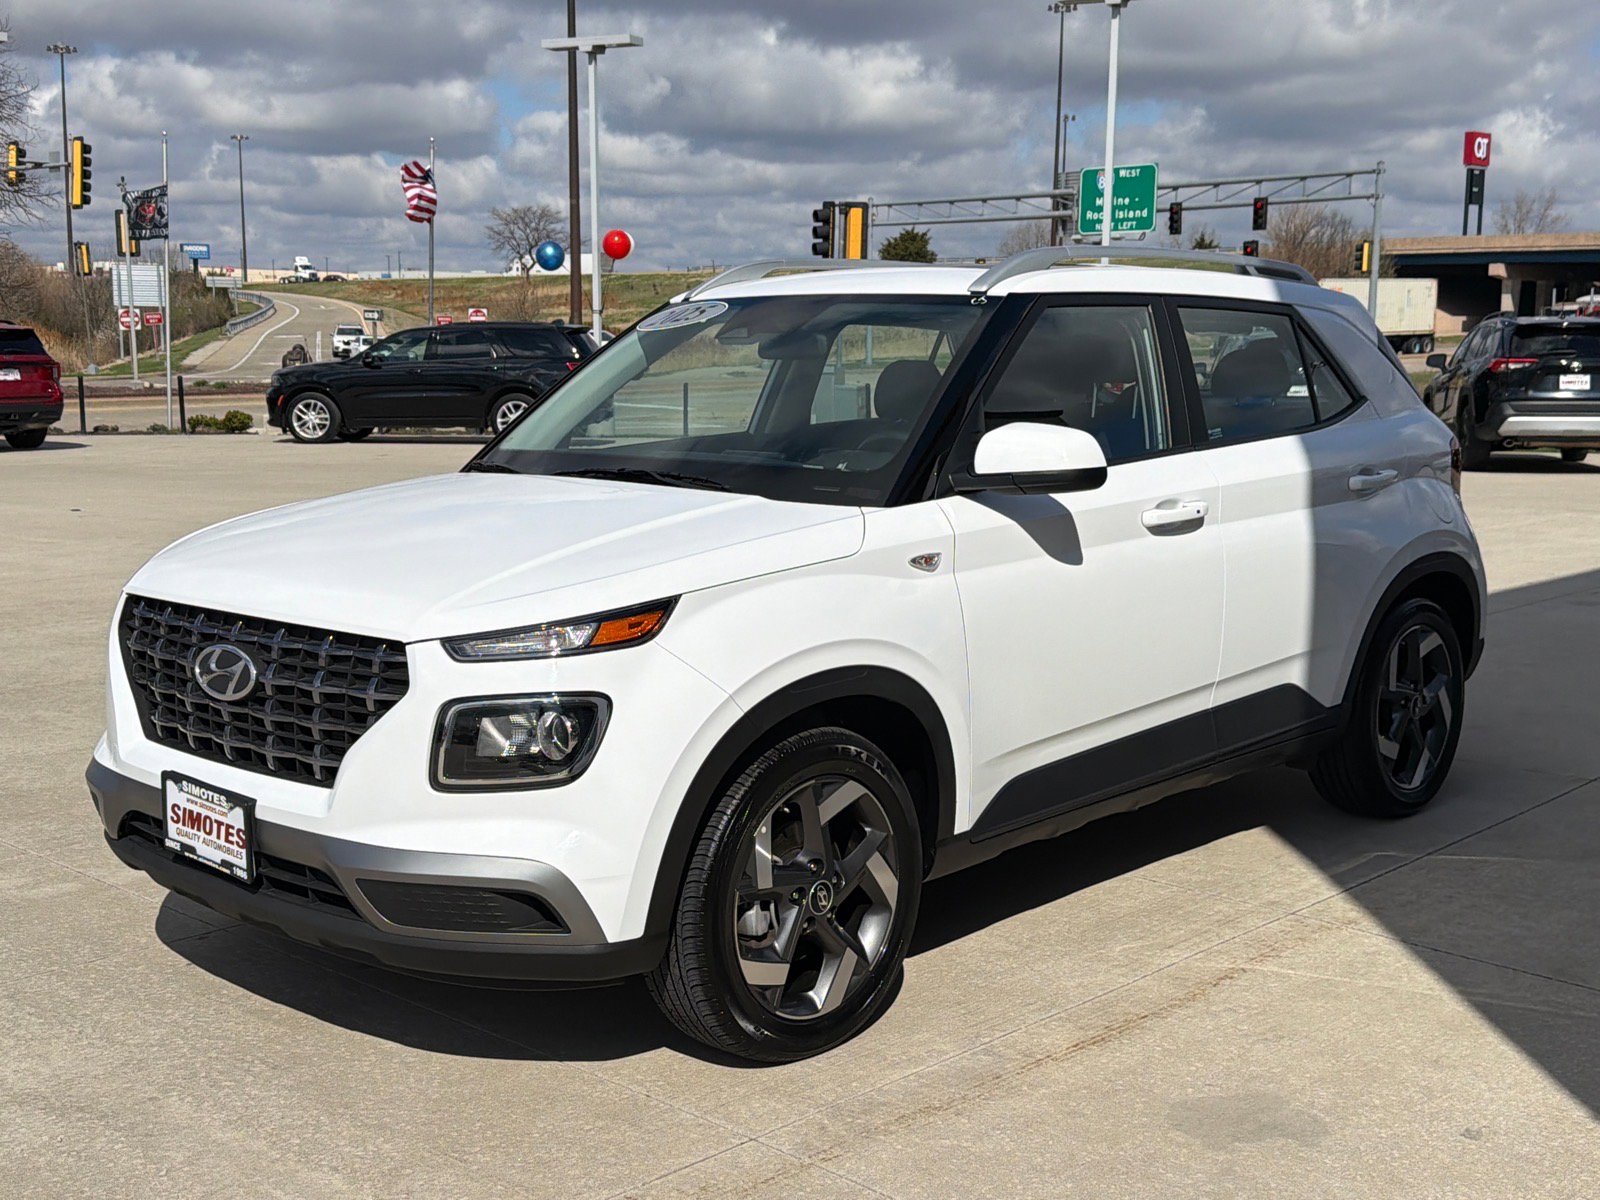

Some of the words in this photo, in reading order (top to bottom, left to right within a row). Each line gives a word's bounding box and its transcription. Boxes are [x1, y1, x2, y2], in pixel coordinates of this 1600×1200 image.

[1119, 168, 1141, 178] WEST
[1095, 195, 1130, 207] Mine
[1086, 210, 1105, 221] Roc
[1115, 207, 1148, 219] Island
[1118, 221, 1137, 230] LEFT
[181, 780, 228, 809] SIMOTES
[170, 802, 247, 850] SIMOTES
[175, 826, 201, 844] QUALITY
[202, 836, 244, 860] AUTOMOBILES
